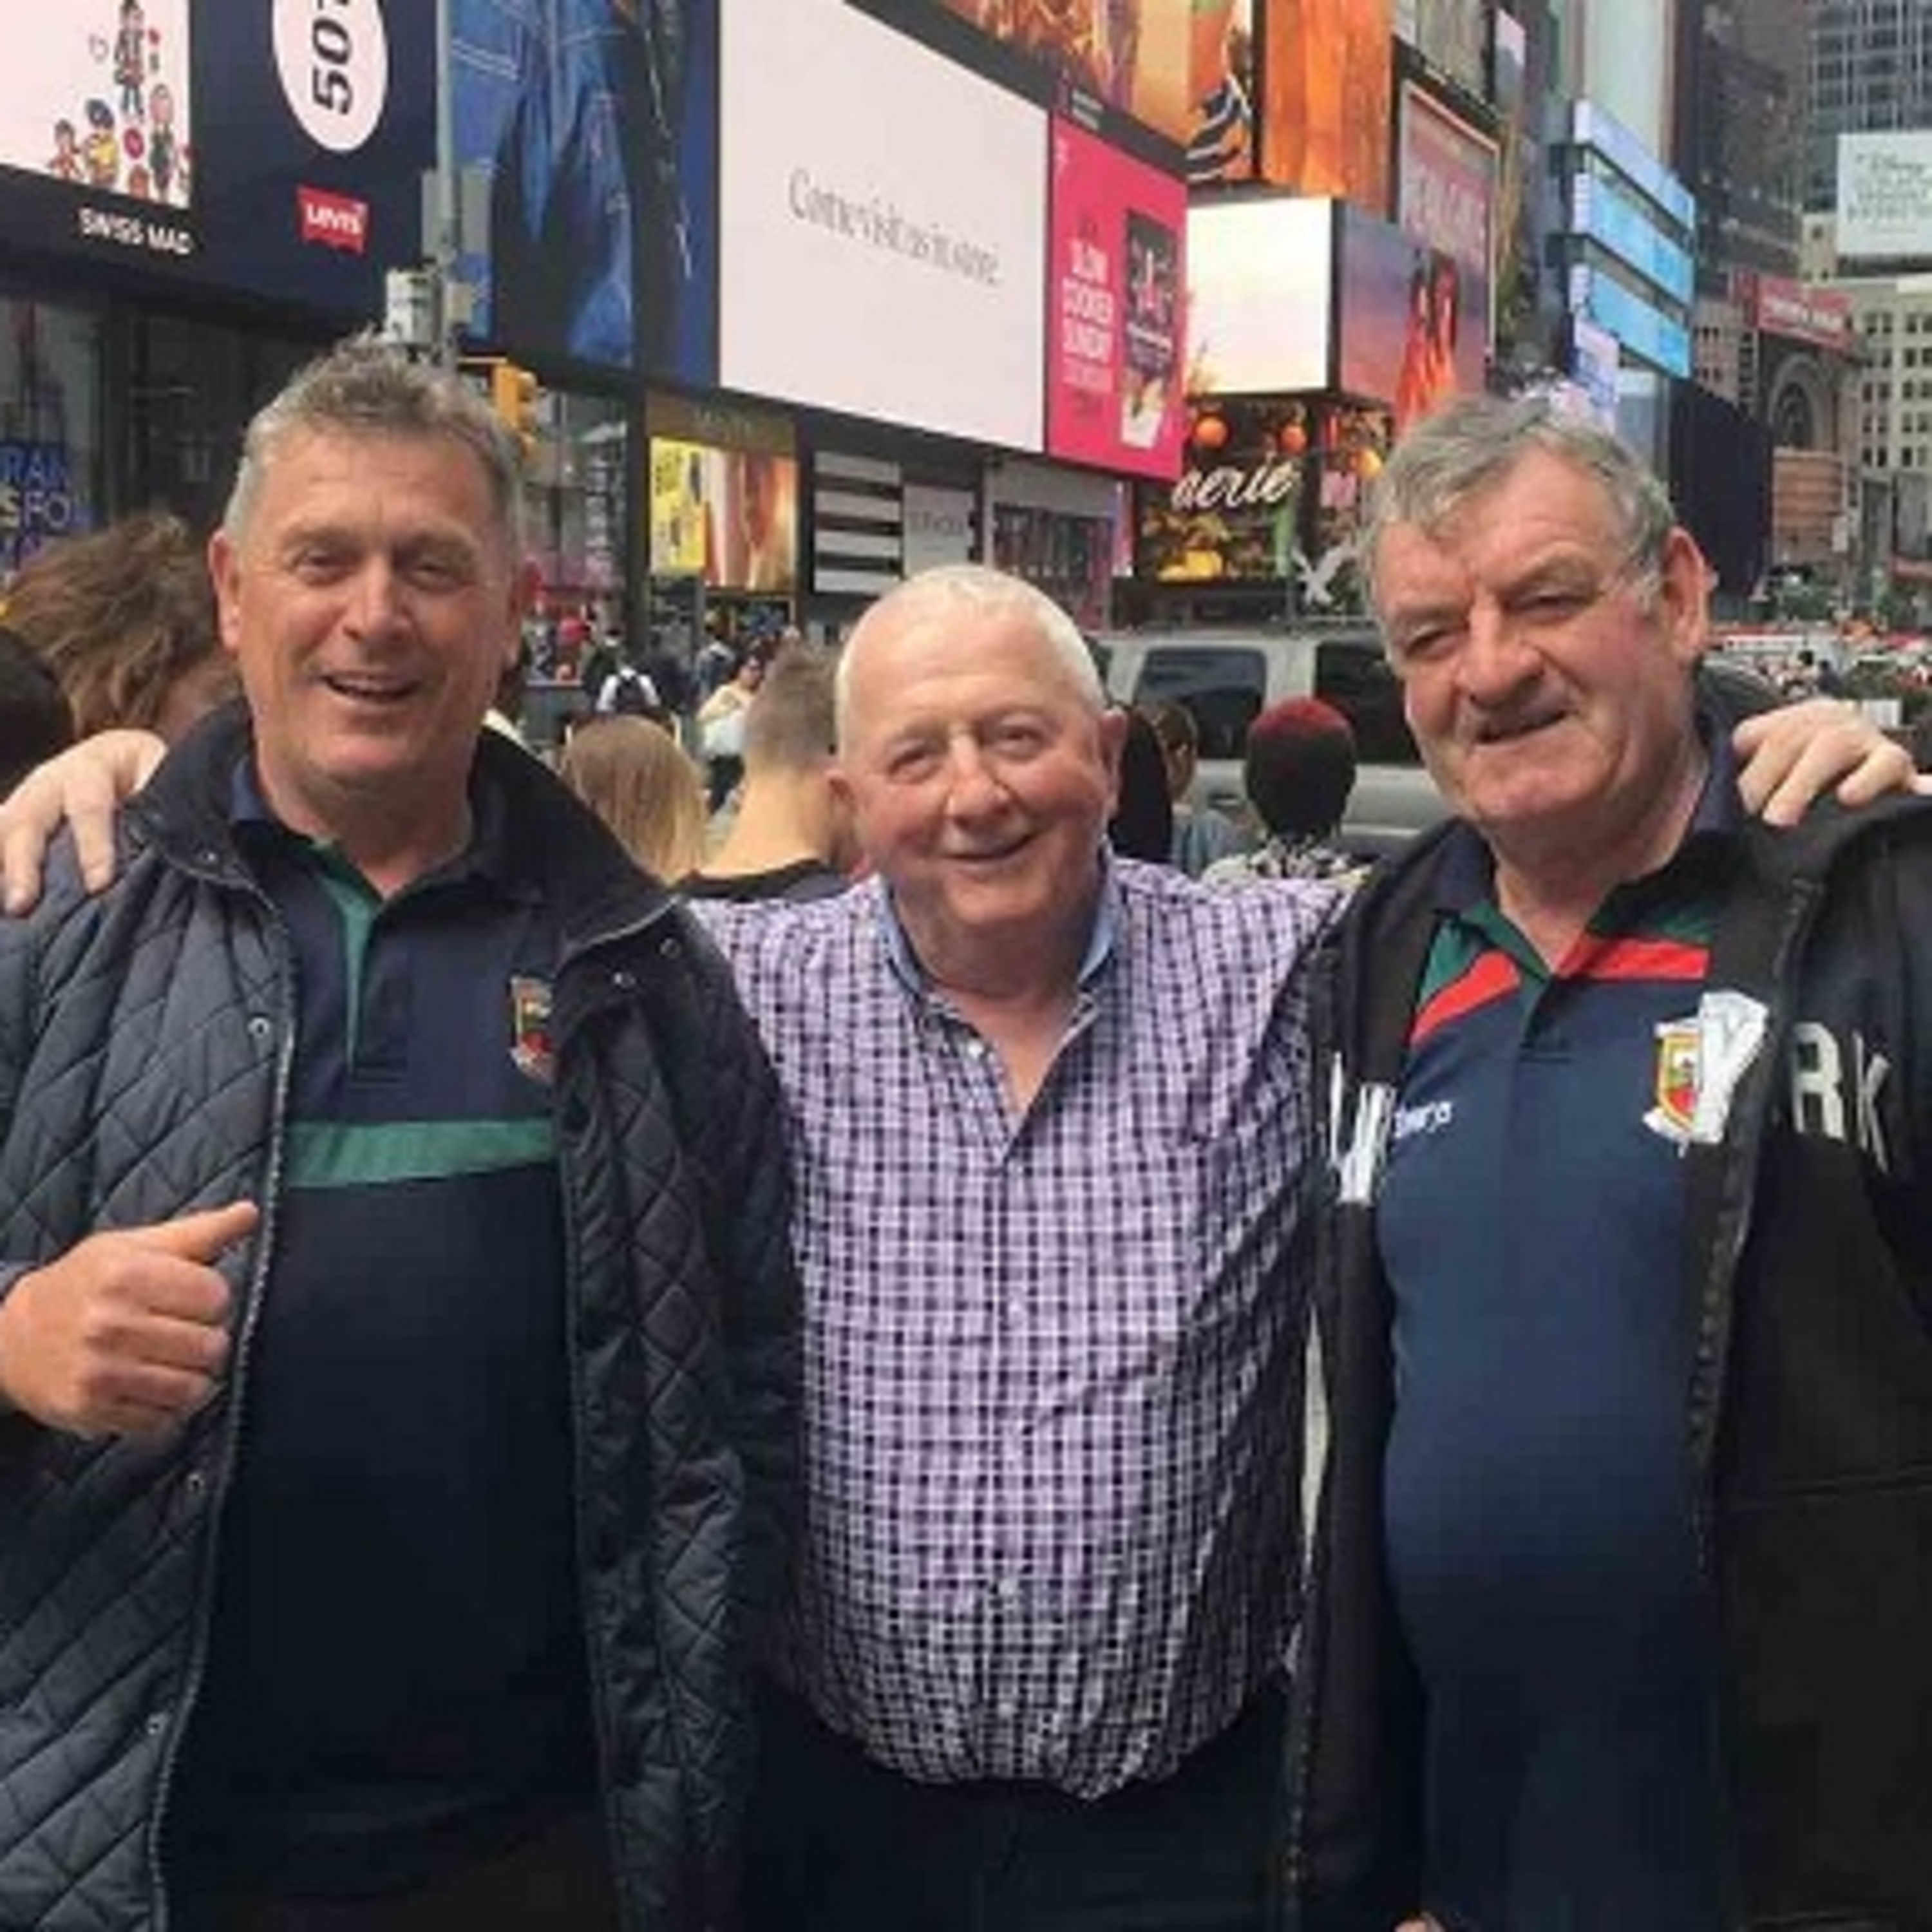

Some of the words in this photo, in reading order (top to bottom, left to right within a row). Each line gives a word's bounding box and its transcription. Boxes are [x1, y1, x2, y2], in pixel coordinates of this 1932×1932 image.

[312, 0, 353, 115] 50
[78, 207, 145, 245] SWISS
[788, 167, 855, 239] Come
[857, 195, 904, 253] visit
[1172, 452, 1294, 510] aerie
